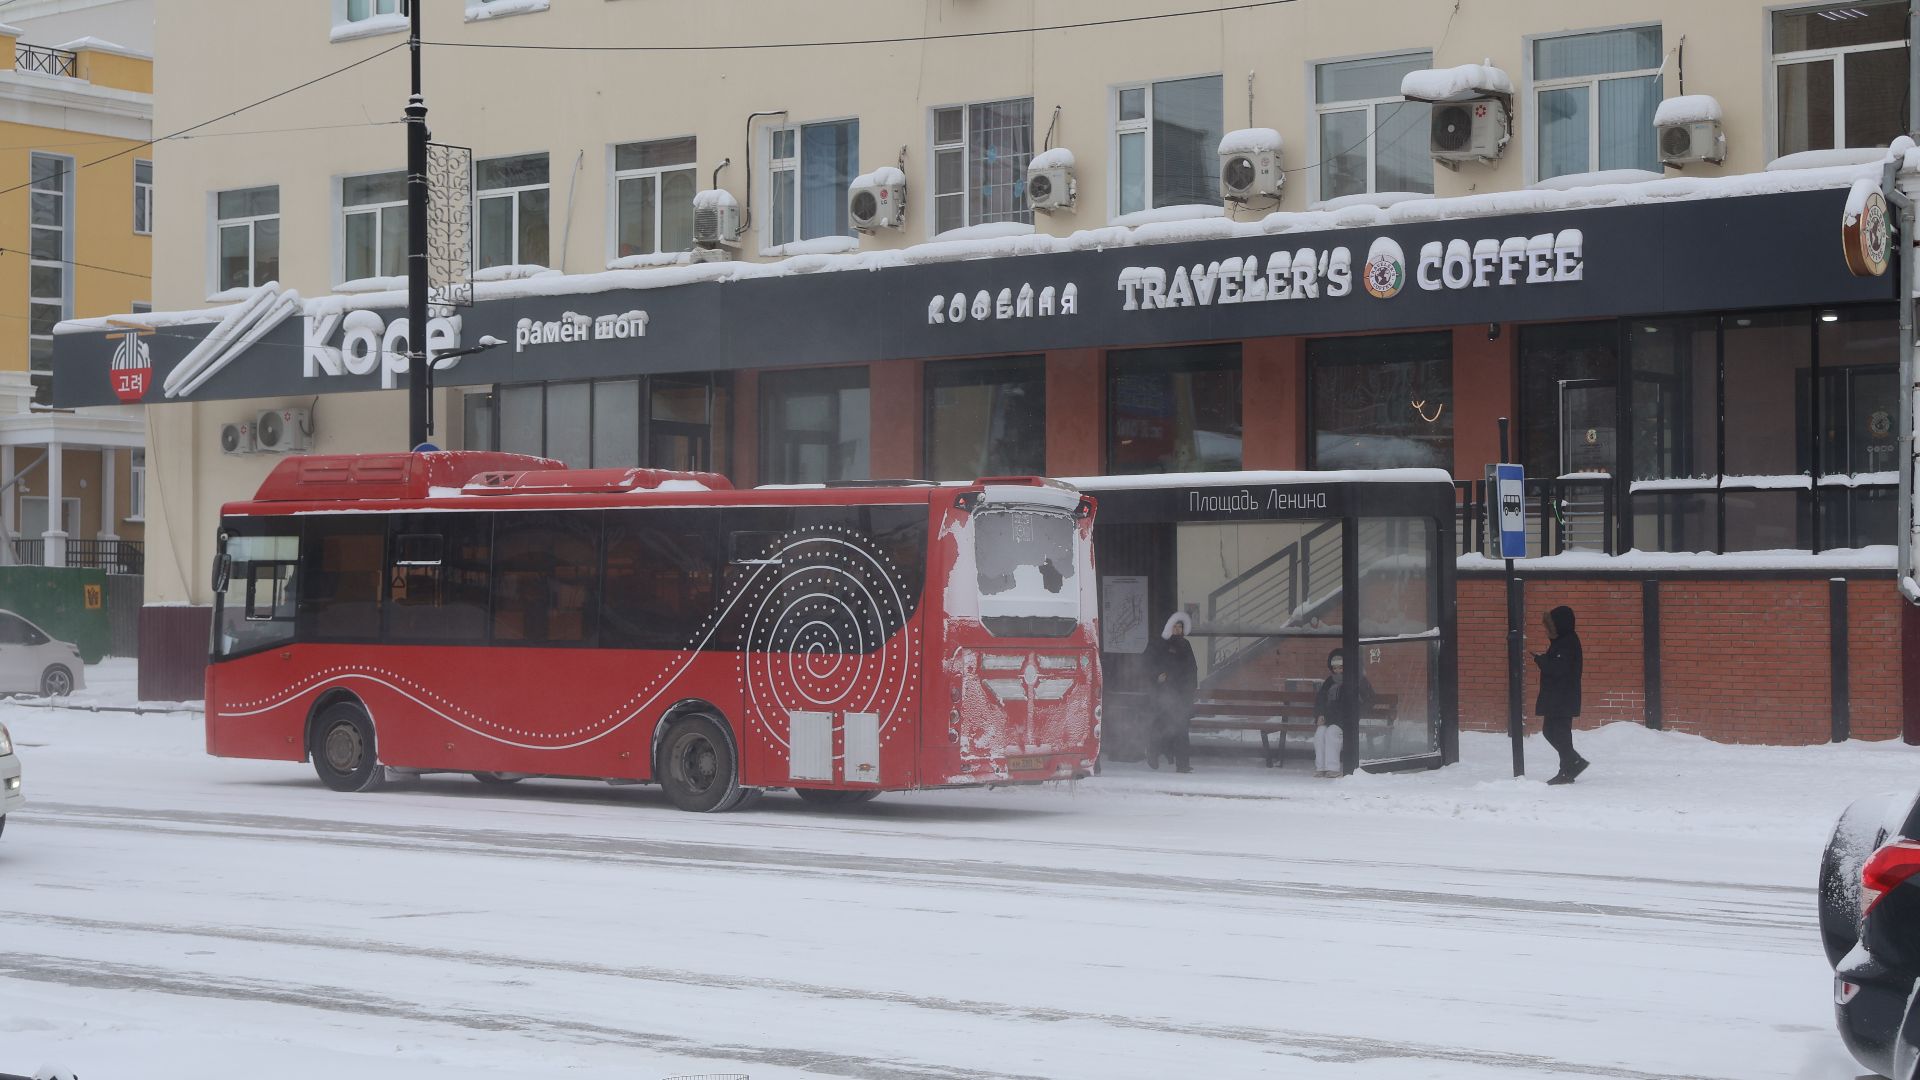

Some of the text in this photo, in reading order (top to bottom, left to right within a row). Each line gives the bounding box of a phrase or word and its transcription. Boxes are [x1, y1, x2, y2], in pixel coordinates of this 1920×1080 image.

[1117, 229, 1583, 311] TRAVELER'S COFFEE
[516, 312, 591, 352] рамён
[595, 311, 648, 340] шоп
[118, 373, 143, 393] 고려
[1189, 488, 1327, 513] Площадь Ленина
